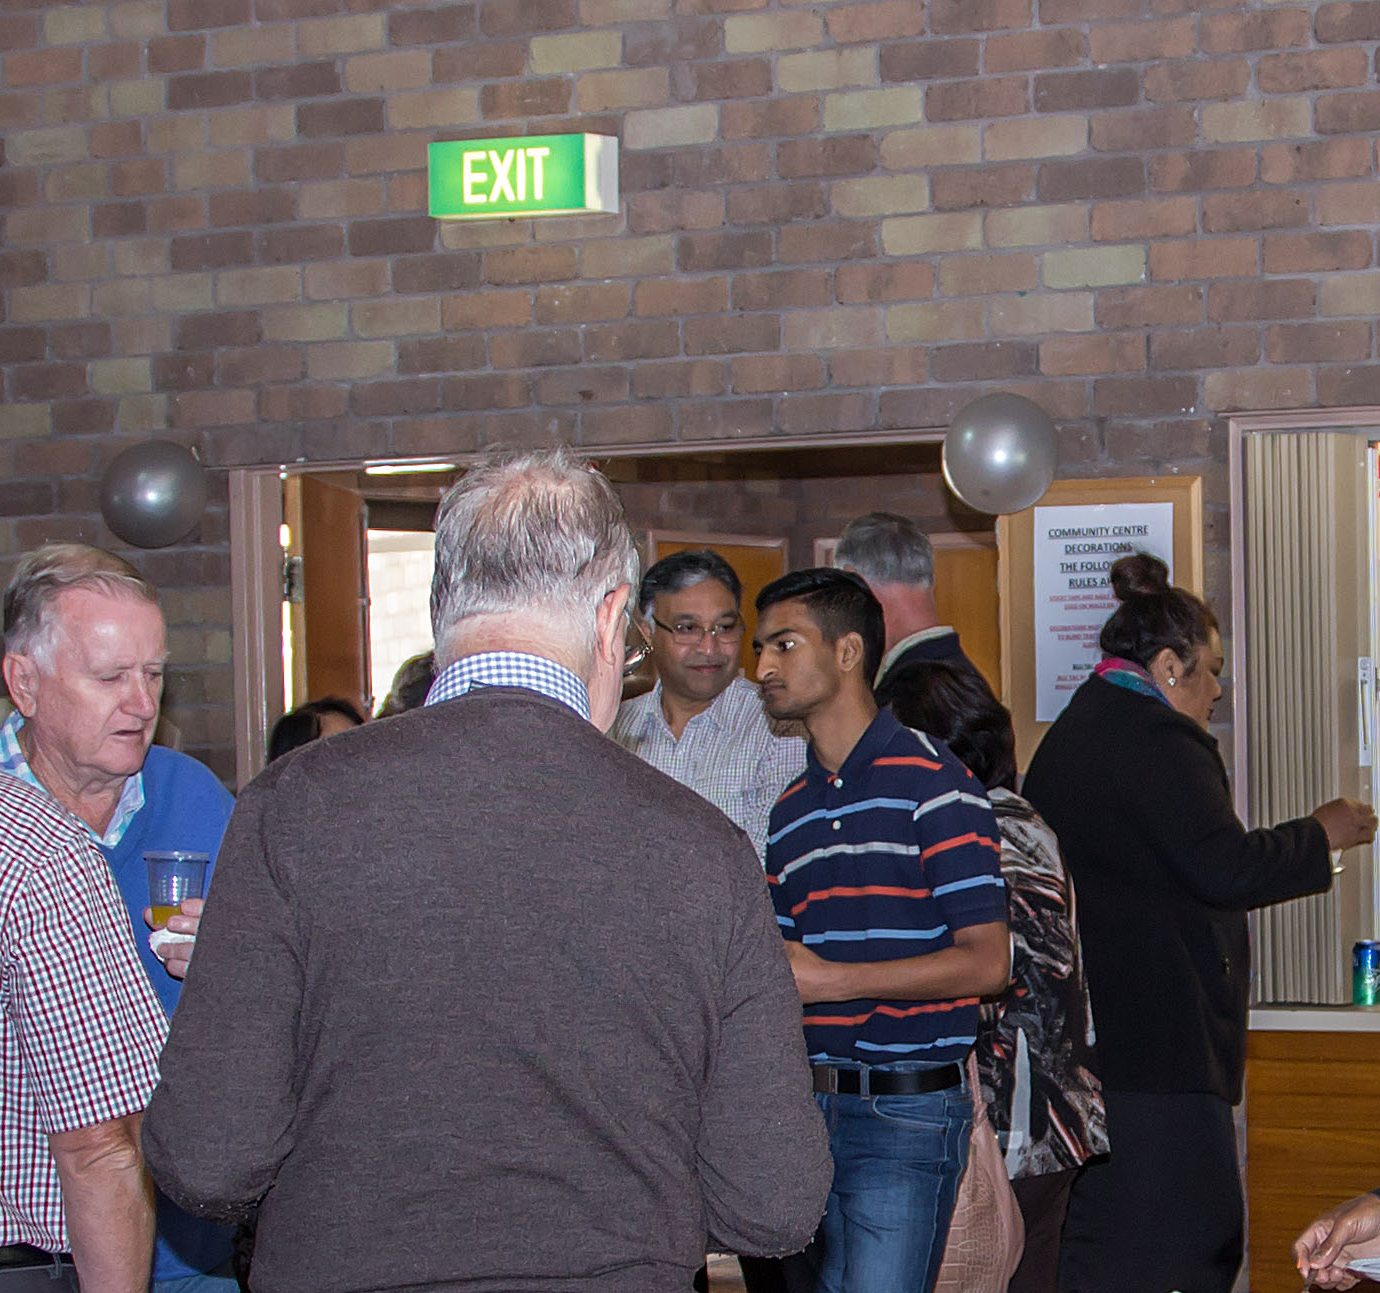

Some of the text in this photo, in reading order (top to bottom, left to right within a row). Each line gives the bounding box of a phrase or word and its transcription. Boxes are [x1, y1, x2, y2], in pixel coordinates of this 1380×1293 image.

[462, 147, 550, 204] EXIT
[1048, 525, 1149, 539] COMMUNITY CENTRE
[1064, 542, 1132, 554] DECORATIONS
[1060, 561, 1113, 573] THE FOLLO
[1068, 578, 1098, 589] RULES
